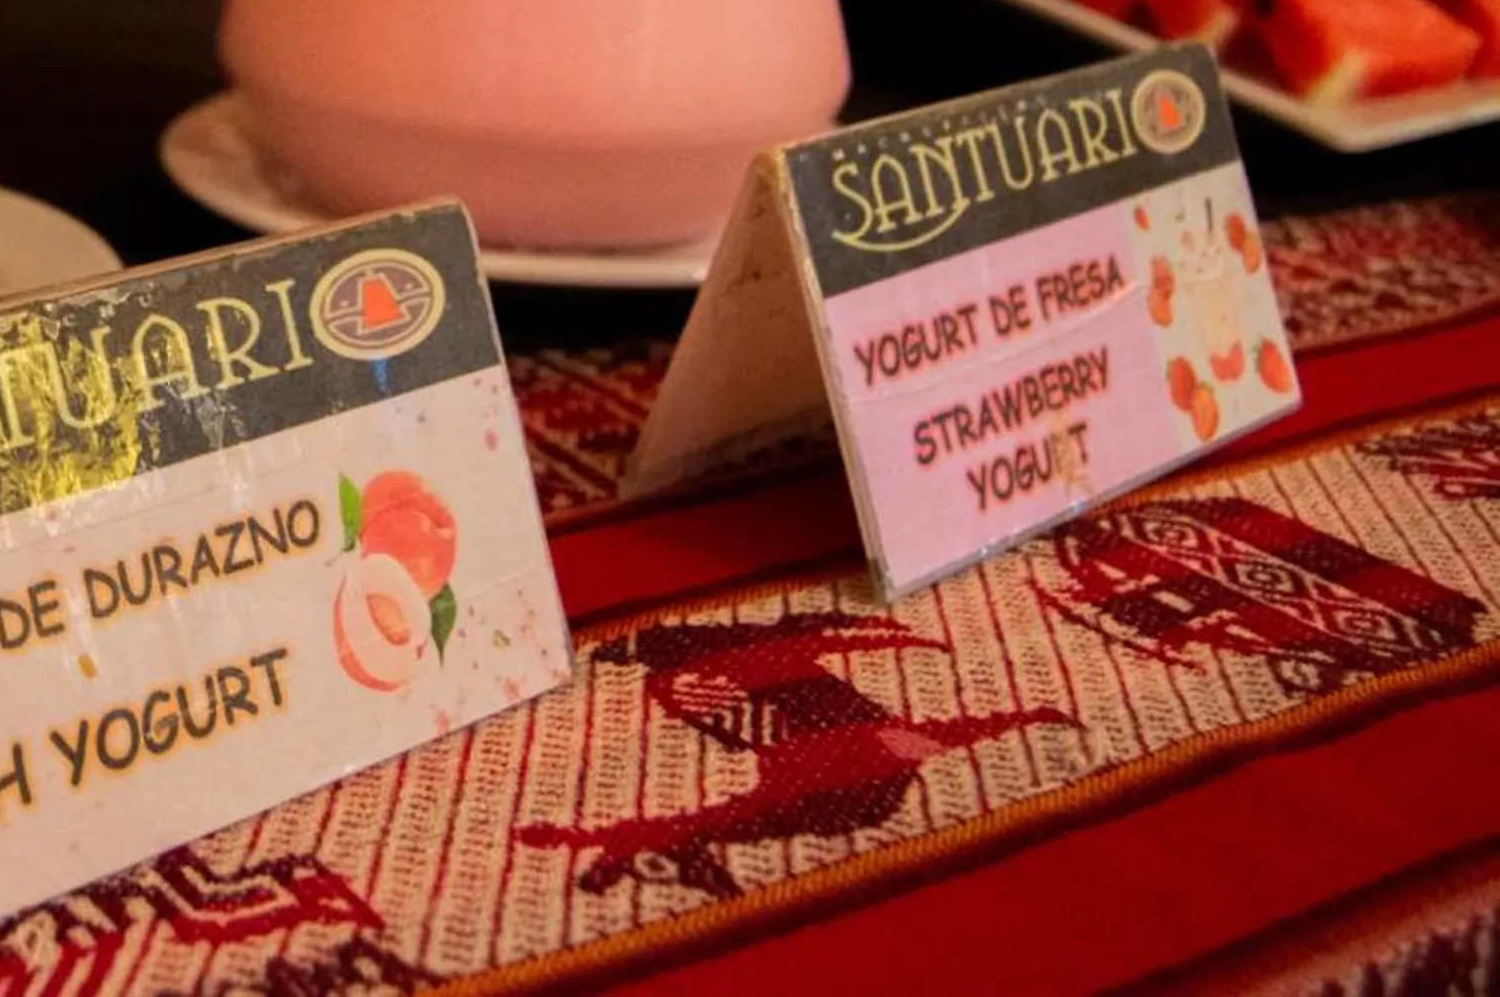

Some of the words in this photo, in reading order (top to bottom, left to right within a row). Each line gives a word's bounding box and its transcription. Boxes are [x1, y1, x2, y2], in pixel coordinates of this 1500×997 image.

[853, 303, 978, 386] YOGURT
[989, 285, 1032, 337] DE
[1036, 253, 1124, 321] FRESA
[913, 345, 1109, 466] STRAWBERRY
[82, 499, 320, 619] DURAZNO
[50, 647, 288, 787] YOGURT
